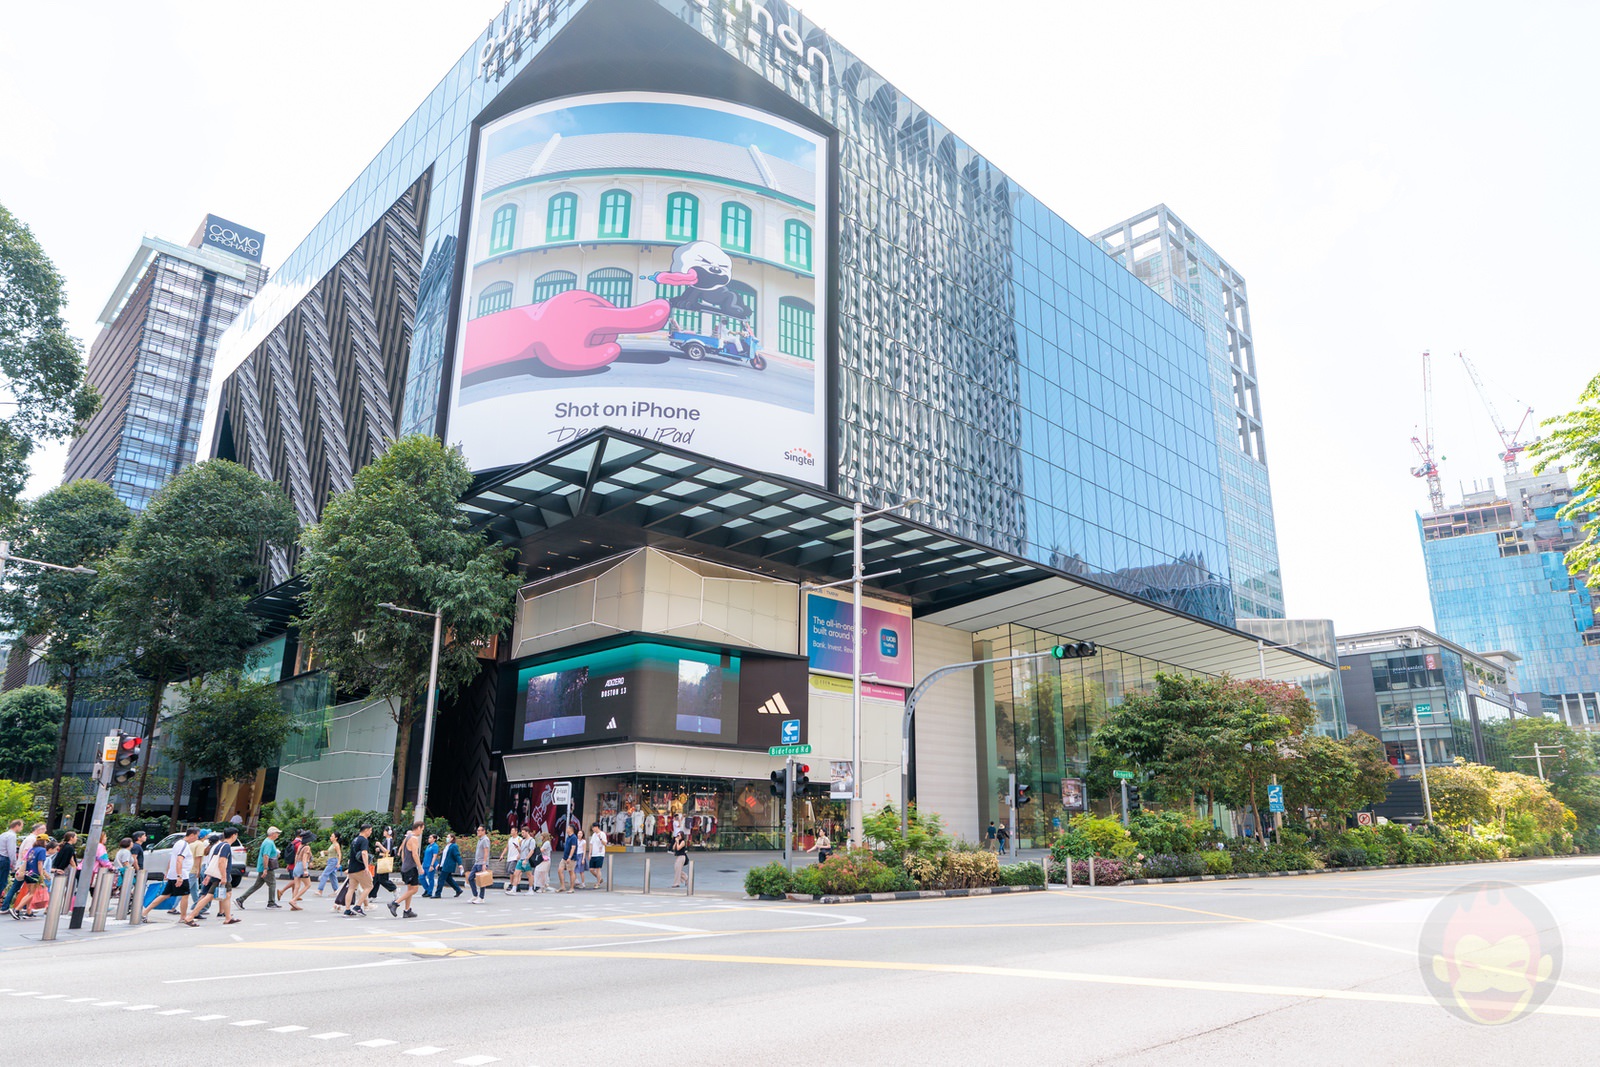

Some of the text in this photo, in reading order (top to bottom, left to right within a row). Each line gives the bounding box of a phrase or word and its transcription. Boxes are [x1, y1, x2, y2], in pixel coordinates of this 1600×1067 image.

[208, 233, 259, 256] ORCHARD
[210, 224, 260, 250] COMO
[554, 401, 701, 421] Shot on iPhone
[652, 427, 695, 444] iPad
[784, 451, 815, 466] Singtel
[813, 615, 825, 626] The
[825, 619, 855, 632] all-in-one
[813, 625, 827, 634] built
[828, 629, 850, 640] around
[812, 640, 826, 649] Bank.
[827, 643, 842, 652] Invest.
[601, 688, 619, 698] BOSTON
[771, 747, 799, 755] Bideford
